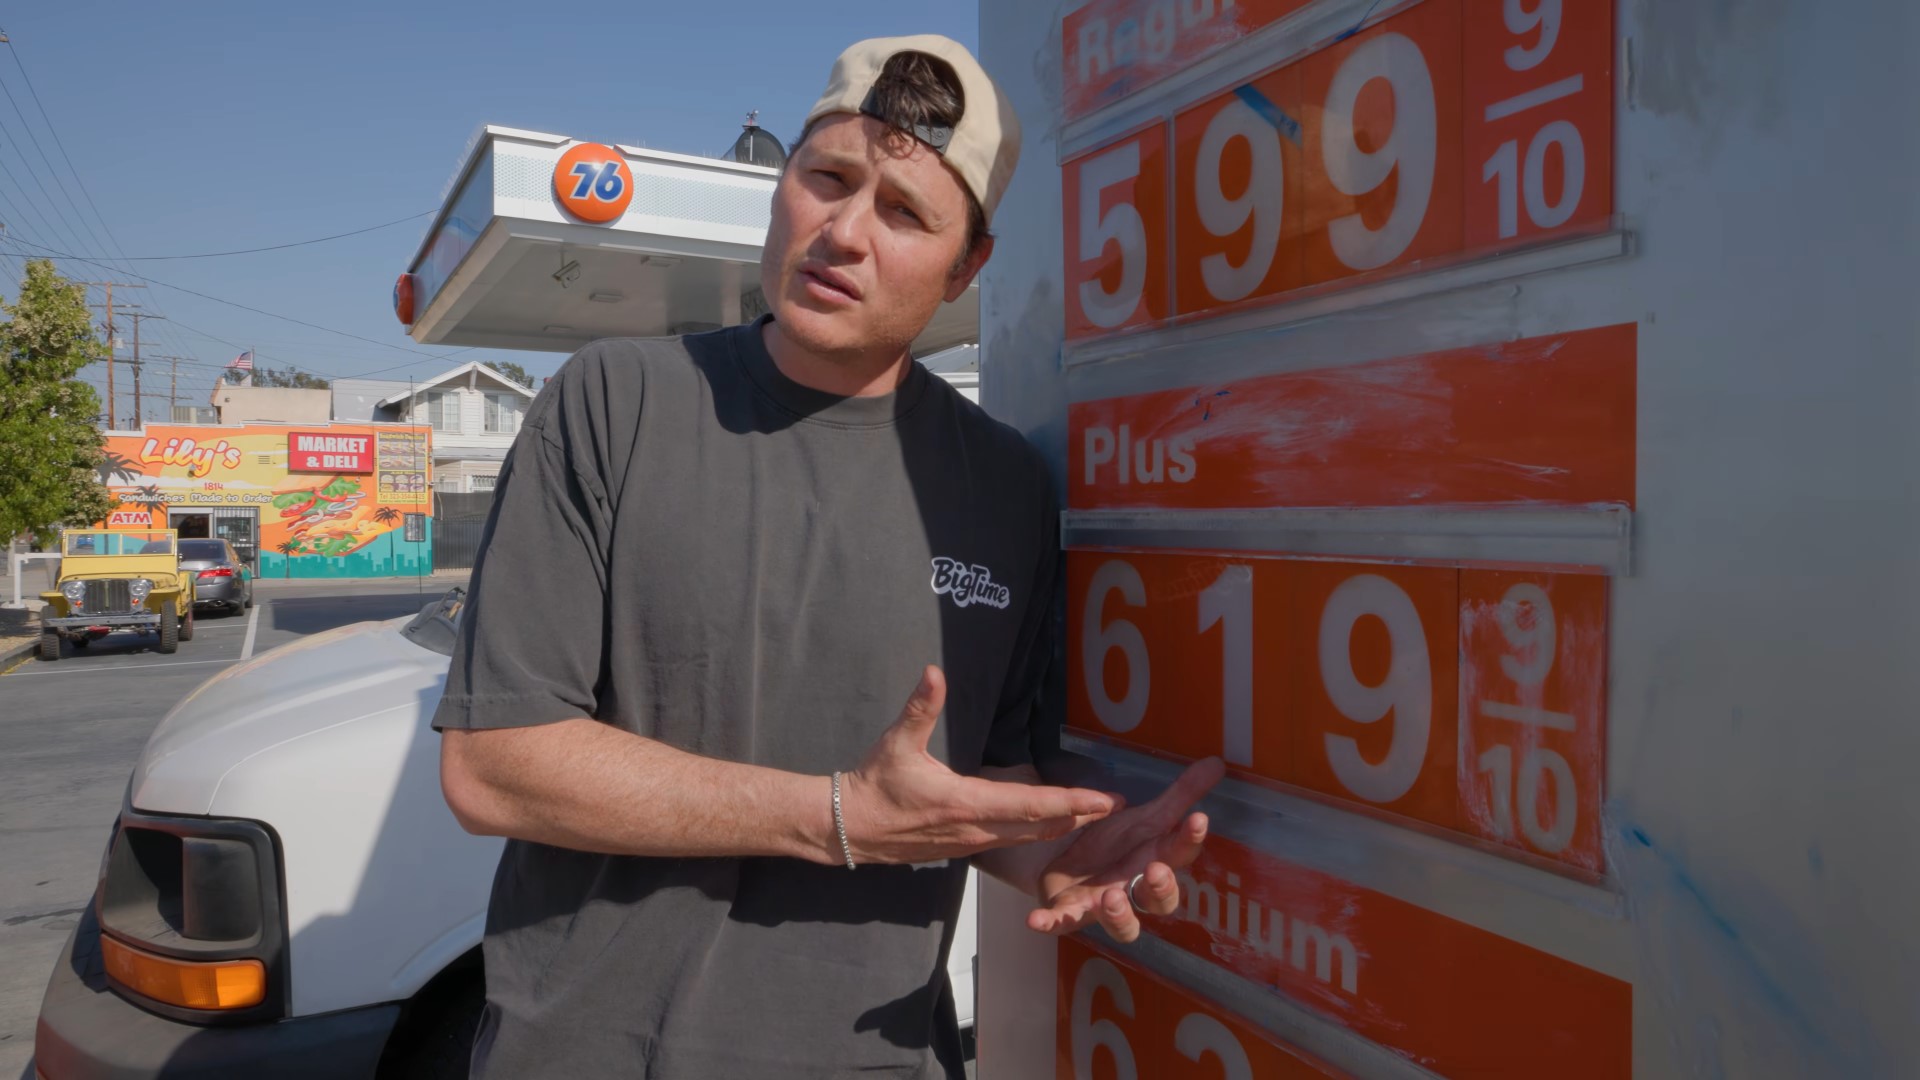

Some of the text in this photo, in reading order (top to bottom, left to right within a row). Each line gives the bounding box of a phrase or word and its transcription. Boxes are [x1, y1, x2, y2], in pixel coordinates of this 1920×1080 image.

[1078, 0, 1236, 84] Regu
[568, 160, 626, 204] 76
[1482, 119, 1586, 240] 10
[139, 437, 241, 478] Lily's
[297, 435, 368, 453] MARKET
[306, 454, 359, 469] & DELI
[1084, 425, 1197, 486] Plus
[118, 494, 273, 503] Sandwiches Made to Order
[204, 482, 224, 491] 1814
[111, 513, 151, 524] ATM
[931, 557, 1010, 609] BigTime
[1500, 582, 1557, 686] 9
[1480, 744, 1578, 854] 10
[1177, 866, 1358, 995] mium
